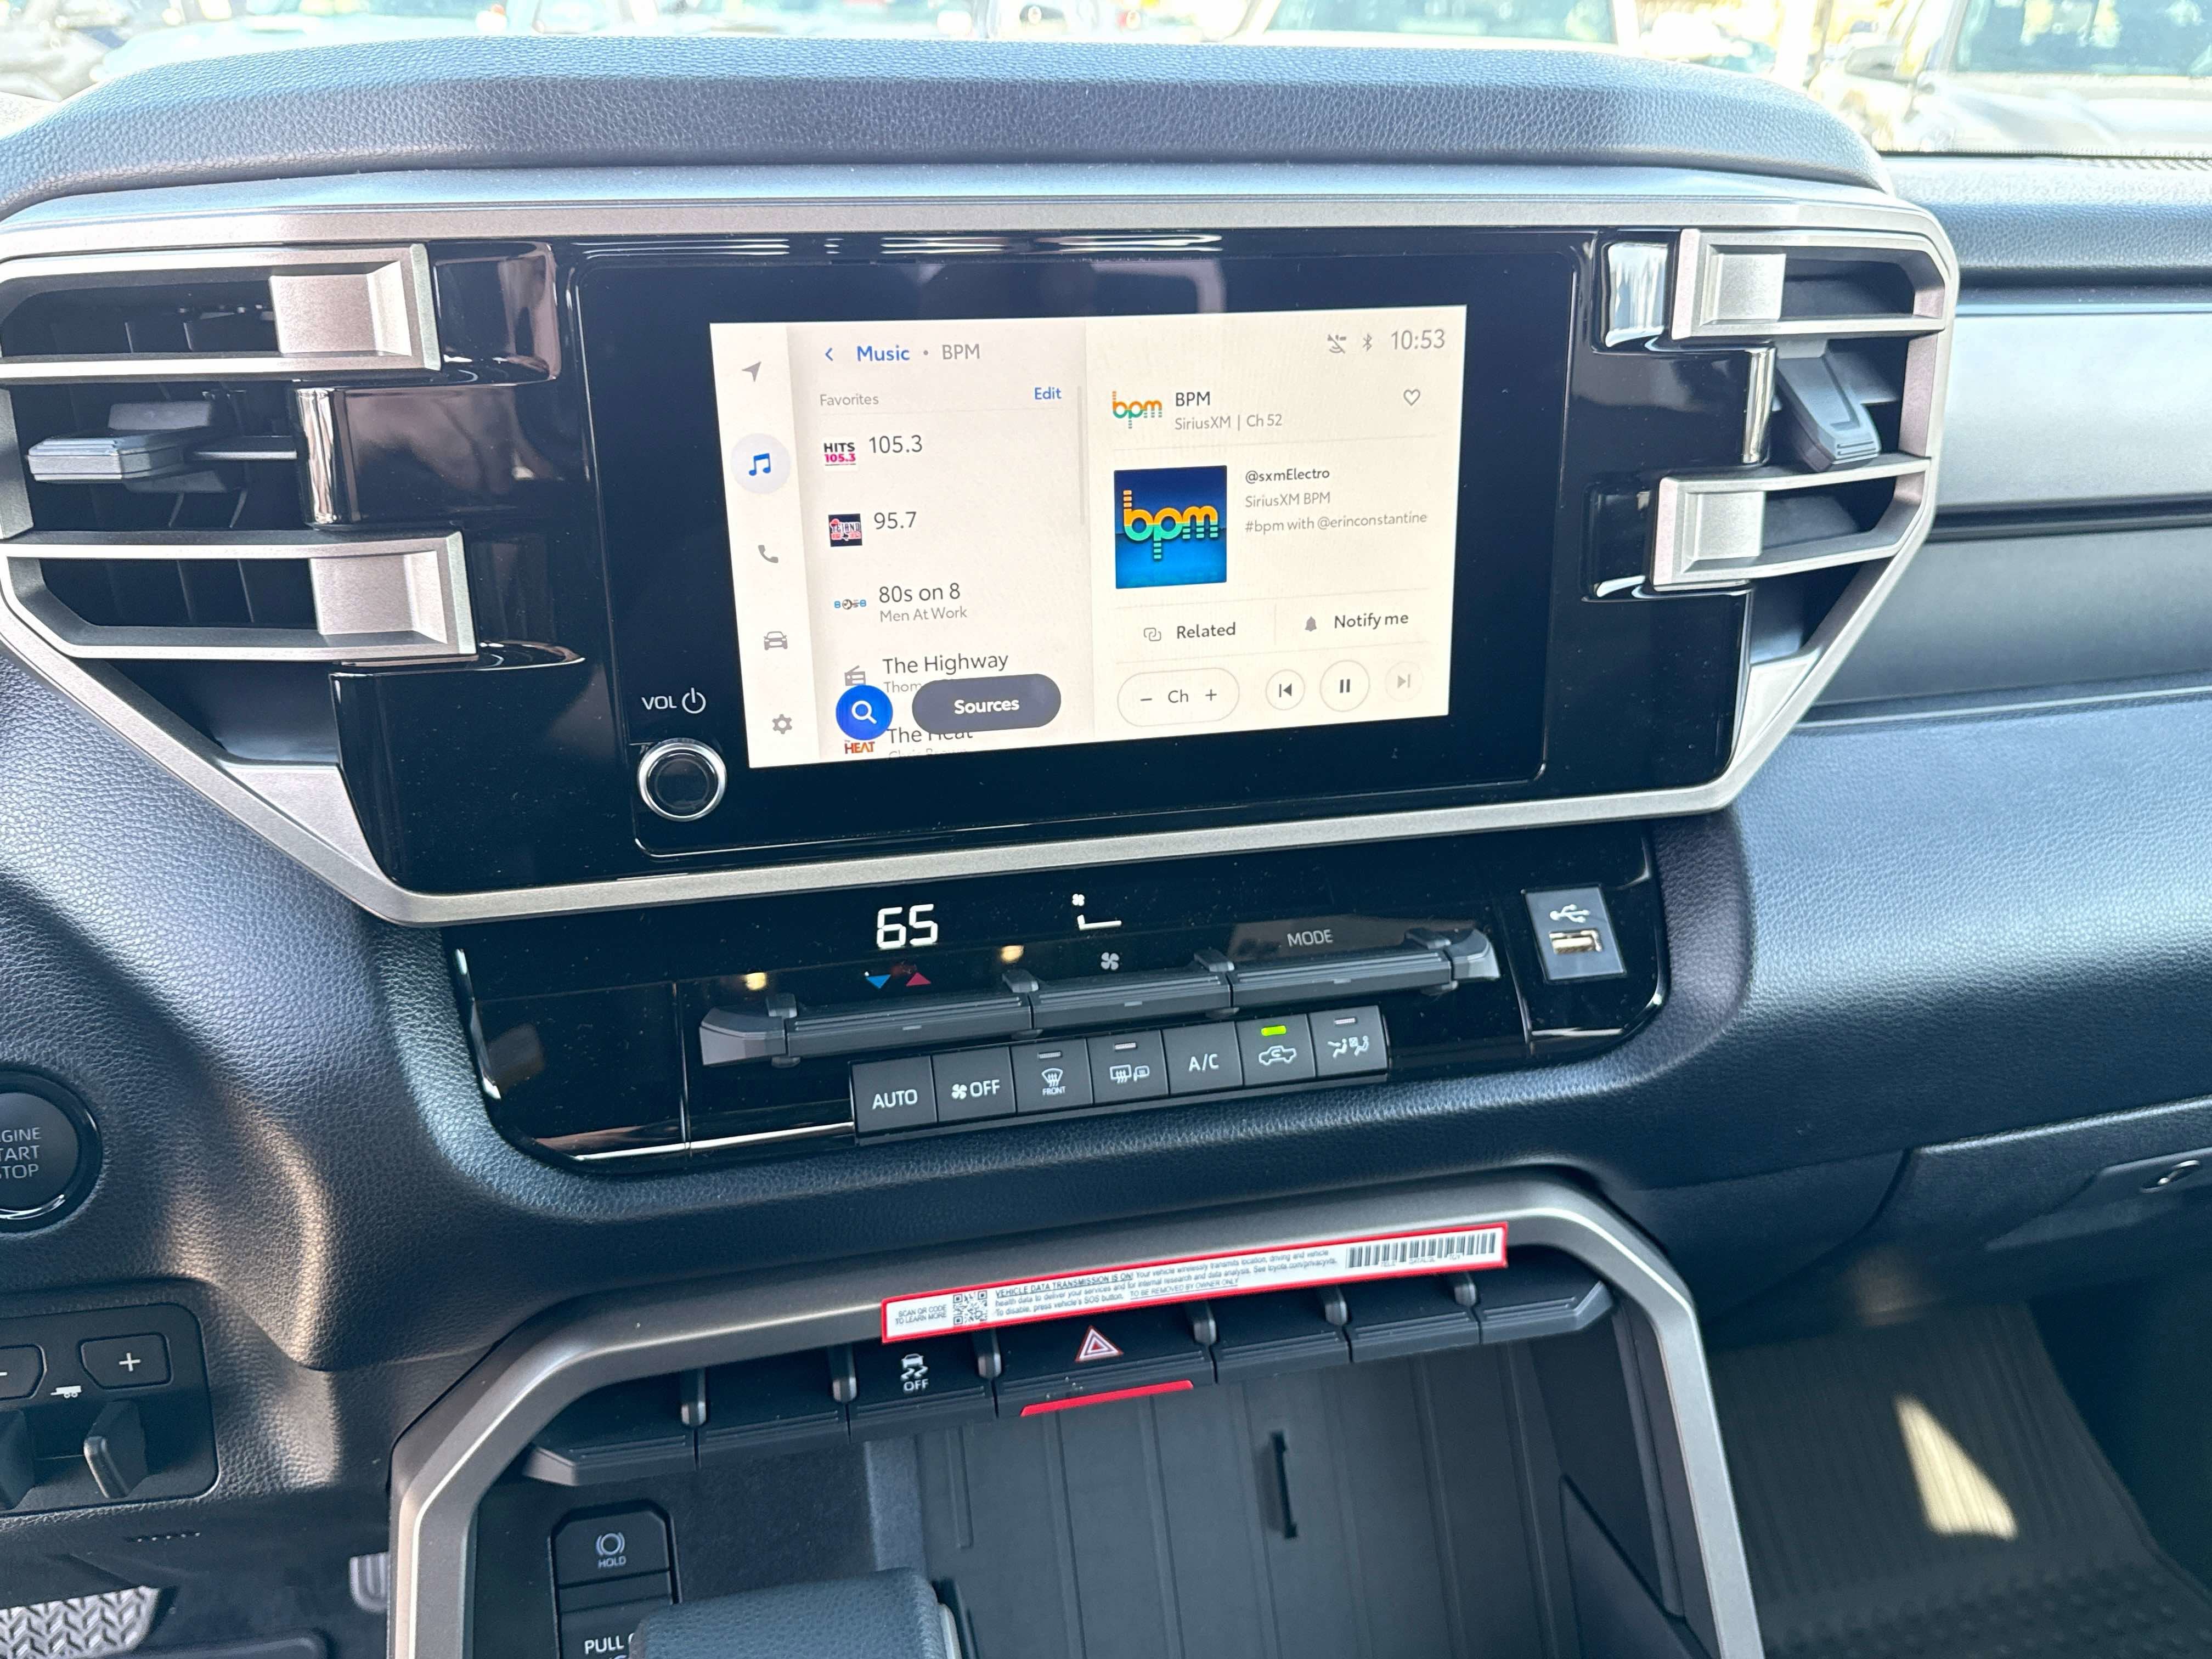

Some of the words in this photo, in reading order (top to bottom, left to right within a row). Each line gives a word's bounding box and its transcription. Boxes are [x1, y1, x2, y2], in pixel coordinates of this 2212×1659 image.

[1391, 329, 1444, 350] 10:53
[856, 345, 910, 362] Music
[942, 343, 981, 360] BPM
[820, 394, 879, 407] Favorites
[1034, 387, 1062, 400] Edit
[1176, 391, 1211, 407] BPM
[1175, 415, 1232, 431] SiriusXM
[1246, 414, 1264, 427] Ch
[1267, 414, 1283, 426] 52
[823, 442, 856, 453] HITS
[869, 435, 923, 454] 105.3
[824, 453, 856, 463] 105.3
[1245, 467, 1330, 484] @sxmElectro
[1245, 493, 1300, 508] SiriusXM
[1304, 492, 1331, 505] BPM
[874, 511, 917, 530] 95.7
[1123, 490, 1218, 560] bpm
[1244, 519, 1285, 536] #bpm
[1288, 517, 1315, 530] with
[1317, 510, 1428, 531] @erinconstantine
[879, 585, 913, 603] 80s
[919, 587, 943, 601] on
[949, 582, 961, 600] 8
[880, 610, 910, 623] Men
[913, 608, 929, 621] At
[930, 605, 968, 619] Work
[1334, 613, 1381, 630] Notify
[1384, 613, 1409, 625] me
[1177, 622, 1237, 639] Related
[882, 657, 918, 674] The
[924, 653, 1009, 675] Highway
[641, 695, 678, 710] VOL
[1167, 690, 1189, 704] Ch
[954, 699, 1020, 715] Sources
[887, 727, 922, 744] The
[844, 741, 876, 754] HEAT
[876, 903, 938, 950] 65
[1286, 929, 1334, 947] MODE
[1188, 1053, 1219, 1072] A/C
[969, 1079, 1001, 1098] OFF
[1042, 1086, 1066, 1096] FRONT
[872, 1088, 918, 1110] AUTO
[0, 1126, 42, 1143] GINE
[0, 1163, 39, 1180] TOP
[995, 1286, 1028, 1296] VEHICLE
[1030, 1283, 1049, 1292] DATA
[1052, 1275, 1109, 1289] TRANSMISSION
[1151, 1284, 1184, 1294] REMOVED
[1018, 1295, 1032, 1304] data
[898, 1308, 916, 1317] SCAN
[928, 1304, 946, 1313] CODE
[906, 1314, 926, 1323] LEARN
[928, 1311, 946, 1320] MORE
[904, 1379, 929, 1392] OFF
[597, 1556, 627, 1568] HOLD
[584, 1635, 624, 1654] PULL
